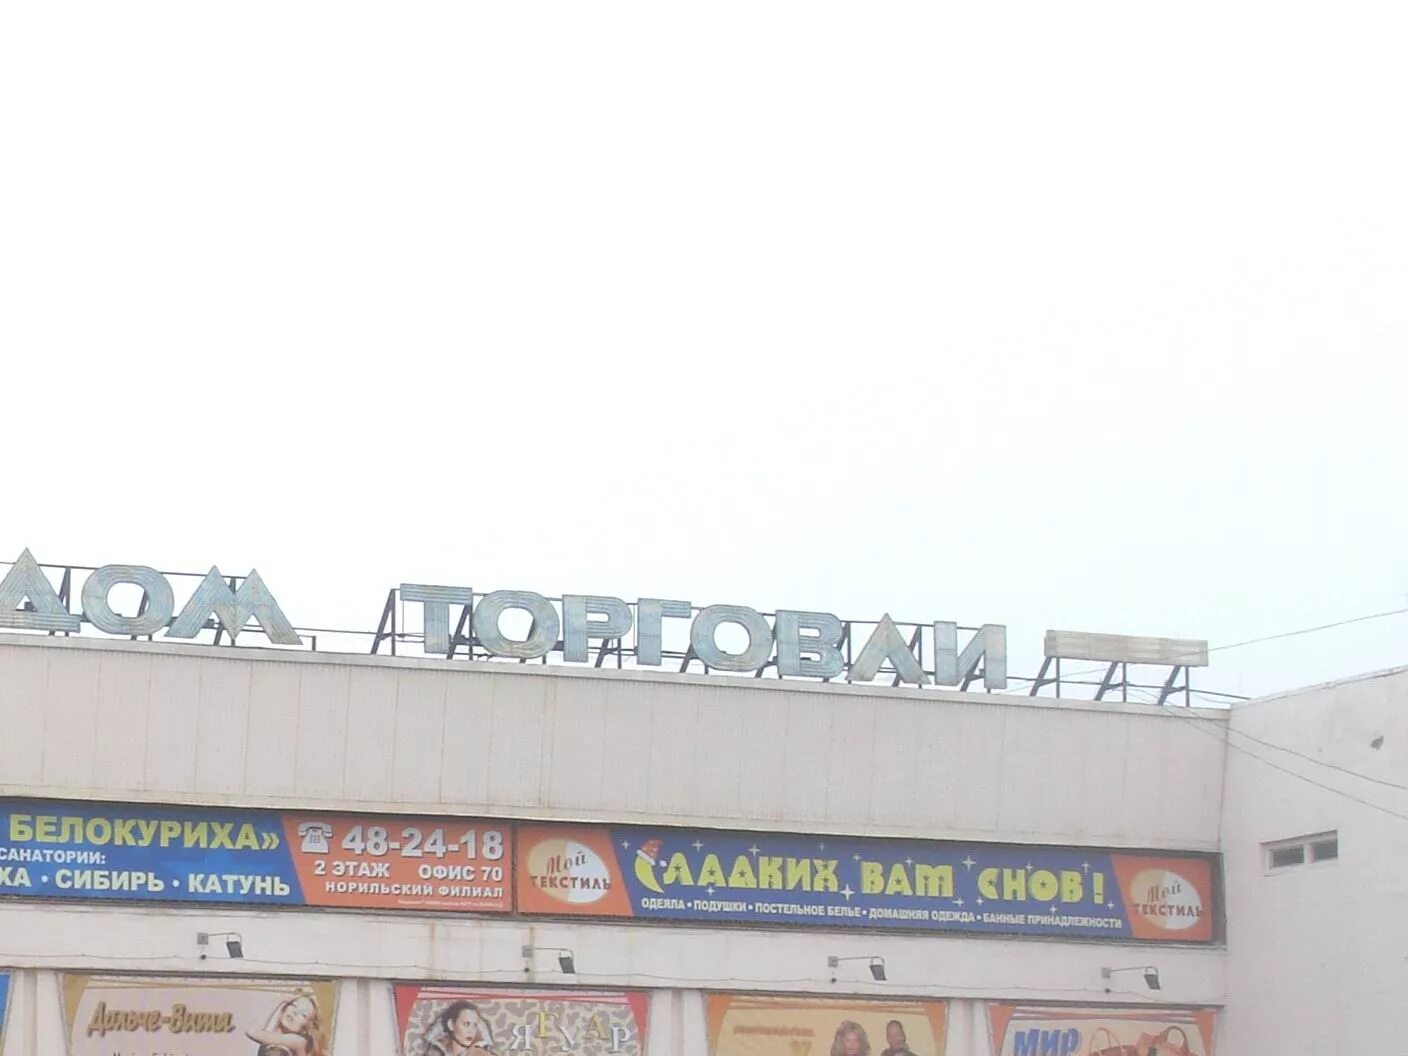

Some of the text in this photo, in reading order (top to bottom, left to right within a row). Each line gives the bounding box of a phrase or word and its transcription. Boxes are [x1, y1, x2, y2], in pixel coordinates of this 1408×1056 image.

[399, 583, 1007, 689] ТОРГОВЛИ
[9, 813, 280, 851] БЕЛОКУРИХА»
[342, 825, 504, 861] 48-24-18
[314, 860, 503, 883] 2 ЭТАЖ ОФИС 70
[546, 851, 588, 875] Мой
[55, 868, 165, 892] СИБИРЬ
[188, 873, 291, 897] КАТУНЬ
[325, 880, 503, 898] НОРИЛЬСКИЙ ФИЛИАЛ
[529, 875, 612, 890] ТЕКСТИЛЬ
[861, 861, 955, 897] ВАМ
[642, 898, 1122, 929] ОДЕЯЛА ПОДУШКИ ПОСТЕЛЬНОЕ БЕЛЬЕ ДОМАШНЯЯ ОДЕЖДА БАННЫЕ ПРИНАДЛЕЖНОСТИ
[1133, 903, 1204, 917] ТЕКСТИЛЬ
[510, 1010, 631, 1054] ЯГУАР
